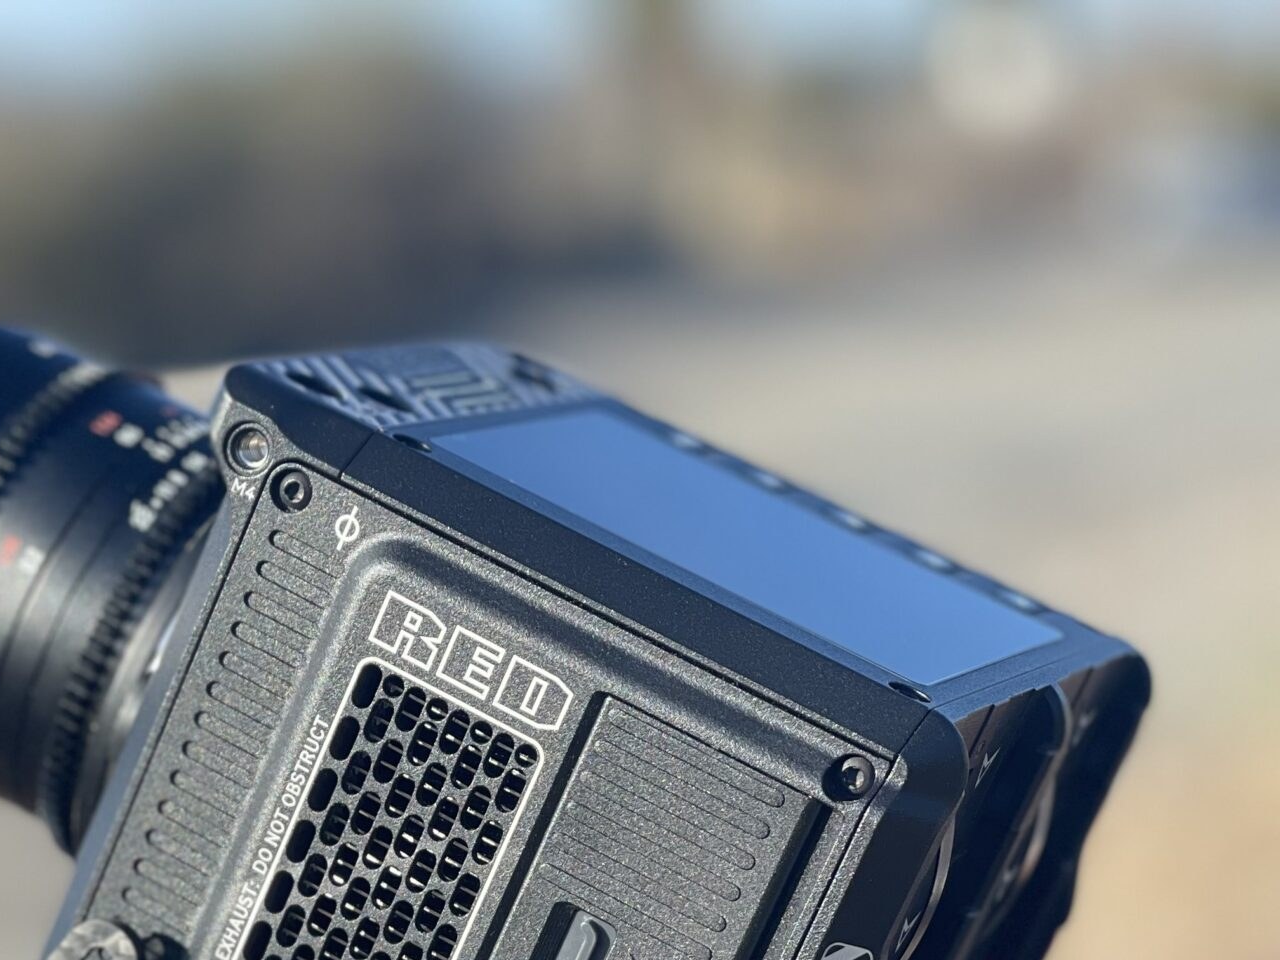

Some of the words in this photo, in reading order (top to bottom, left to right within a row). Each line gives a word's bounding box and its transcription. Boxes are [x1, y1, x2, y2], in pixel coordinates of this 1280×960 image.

[230, 477, 256, 501] M4
[368, 589, 575, 732] RED
[252, 847, 273, 876] DO
[263, 807, 290, 848] NOT
[281, 714, 329, 808] OBSTRUCT
